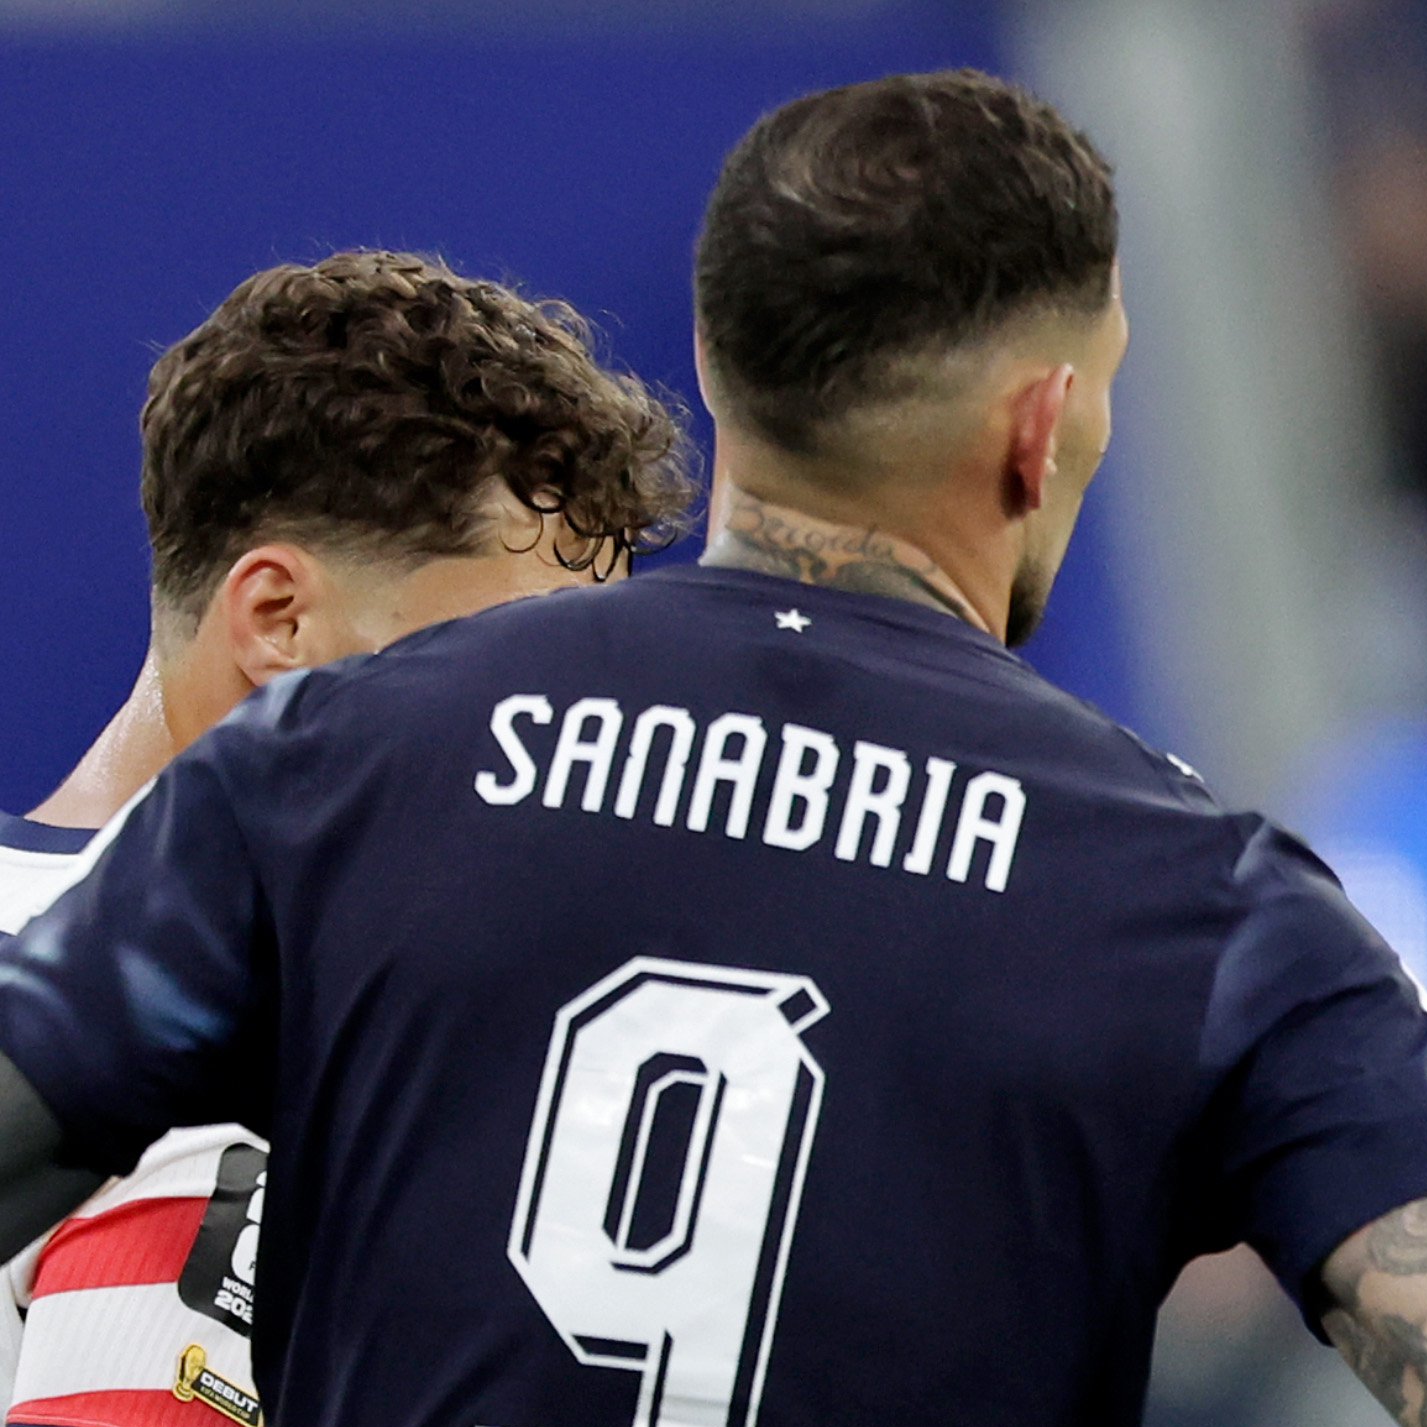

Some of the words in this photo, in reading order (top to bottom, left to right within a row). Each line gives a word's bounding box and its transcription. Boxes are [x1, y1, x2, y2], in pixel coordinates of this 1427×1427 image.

[474, 694, 1027, 892] SANABRIA
[214, 1289, 253, 1325] 202
[222, 1276, 254, 1304] WORL
[200, 1371, 259, 1413] DEBUT
